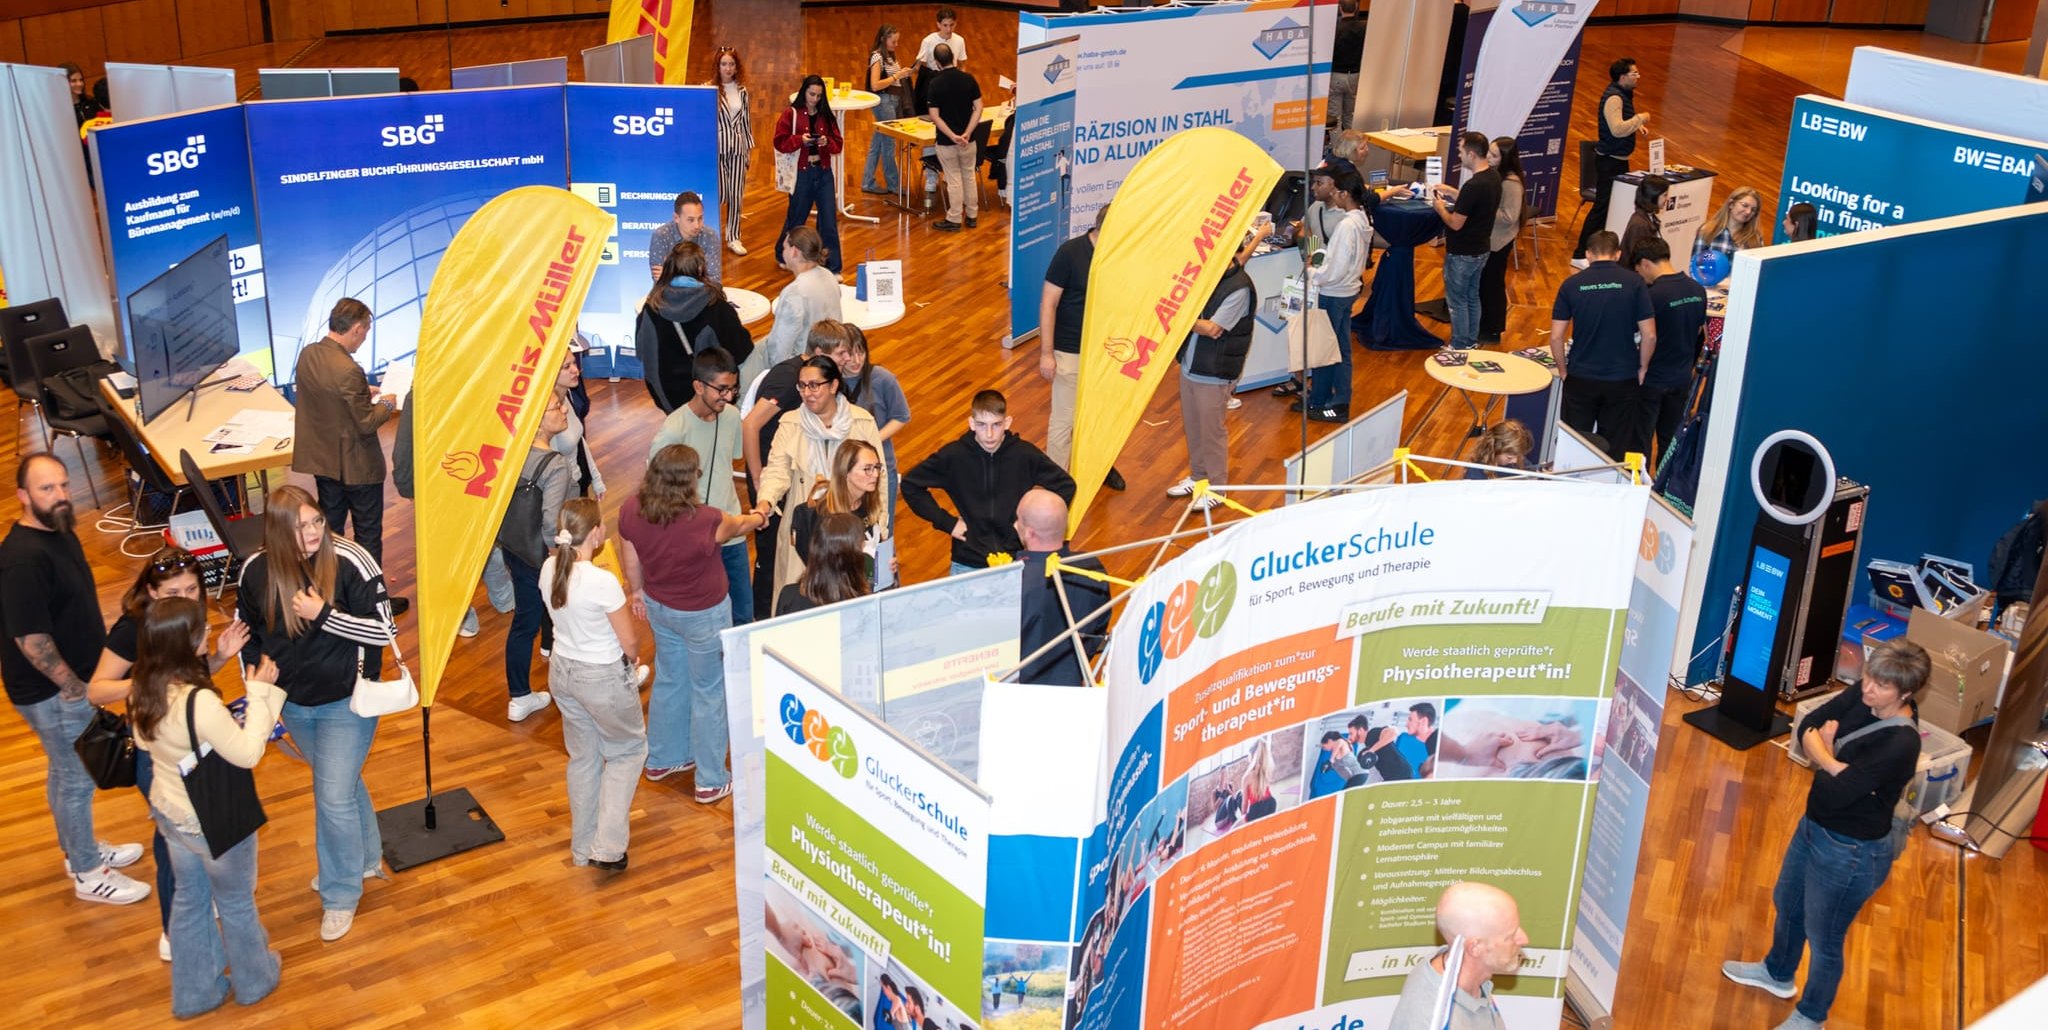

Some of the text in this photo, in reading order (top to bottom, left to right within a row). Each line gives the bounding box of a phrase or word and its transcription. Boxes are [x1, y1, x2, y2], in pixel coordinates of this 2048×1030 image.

[1527, 3, 1570, 13] HABA
[1265, 30, 1304, 41] HABA
[381, 125, 436, 147] SBG
[613, 114, 665, 136] SBG
[1075, 108, 1234, 143] RÄZISION IN STAHL
[147, 146, 200, 176] SBG
[1020, 146, 1033, 158] AUS
[1075, 147, 1100, 165] ND
[280, 155, 545, 185] SINDELFINGER BUCHFÜHRUNGSGESELLSCHAFT mbH
[125, 190, 200, 213] Ausbildung zum
[1791, 176, 1859, 211] Looking
[1862, 194, 1890, 215] for
[1892, 204, 1905, 219] a
[126, 204, 190, 226] Kaufmann für
[128, 206, 241, 239] Büromanagement (w/m/d)
[1193, 166, 1254, 264] Müller
[1817, 204, 1835, 223] in
[528, 224, 586, 346] Müller
[1154, 261, 1201, 335] Alois
[496, 345, 541, 437] Alois
[1250, 521, 1435, 581] GluckerSchule
[1249, 557, 1431, 607] für Sport, Bewegung und Therapie
[1346, 598, 1540, 629] Berufe mit Zukunft!
[1402, 646, 1439, 658] Werde
[1442, 644, 1491, 658] staatlich
[1173, 664, 1341, 742] Sport- und Bewegungs-
[866, 756, 968, 840] GluckerSchule
[1381, 801, 1408, 809] Dauer:
[1440, 797, 1461, 806] Jahre
[1380, 812, 1502, 825] Jobgarantie mit vielfältigen und
[1379, 825, 1508, 836] zahlreichen Einsatzmöglichkeiten
[806, 812, 837, 845] Werde
[838, 838, 879, 877] staatlich
[1377, 843, 1414, 852] Moderner
[1416, 841, 1448, 850] Campus
[1466, 840, 1504, 848] familiärer
[1376, 853, 1439, 864] Lernatmosphäre
[1374, 866, 1542, 879] Voraussetzung: Mittlerer Bildungsabschluss
[1373, 882, 1388, 891] und
[771, 859, 884, 957] Beruf mit Zukunft!
[1381, 954, 1399, 969] in
